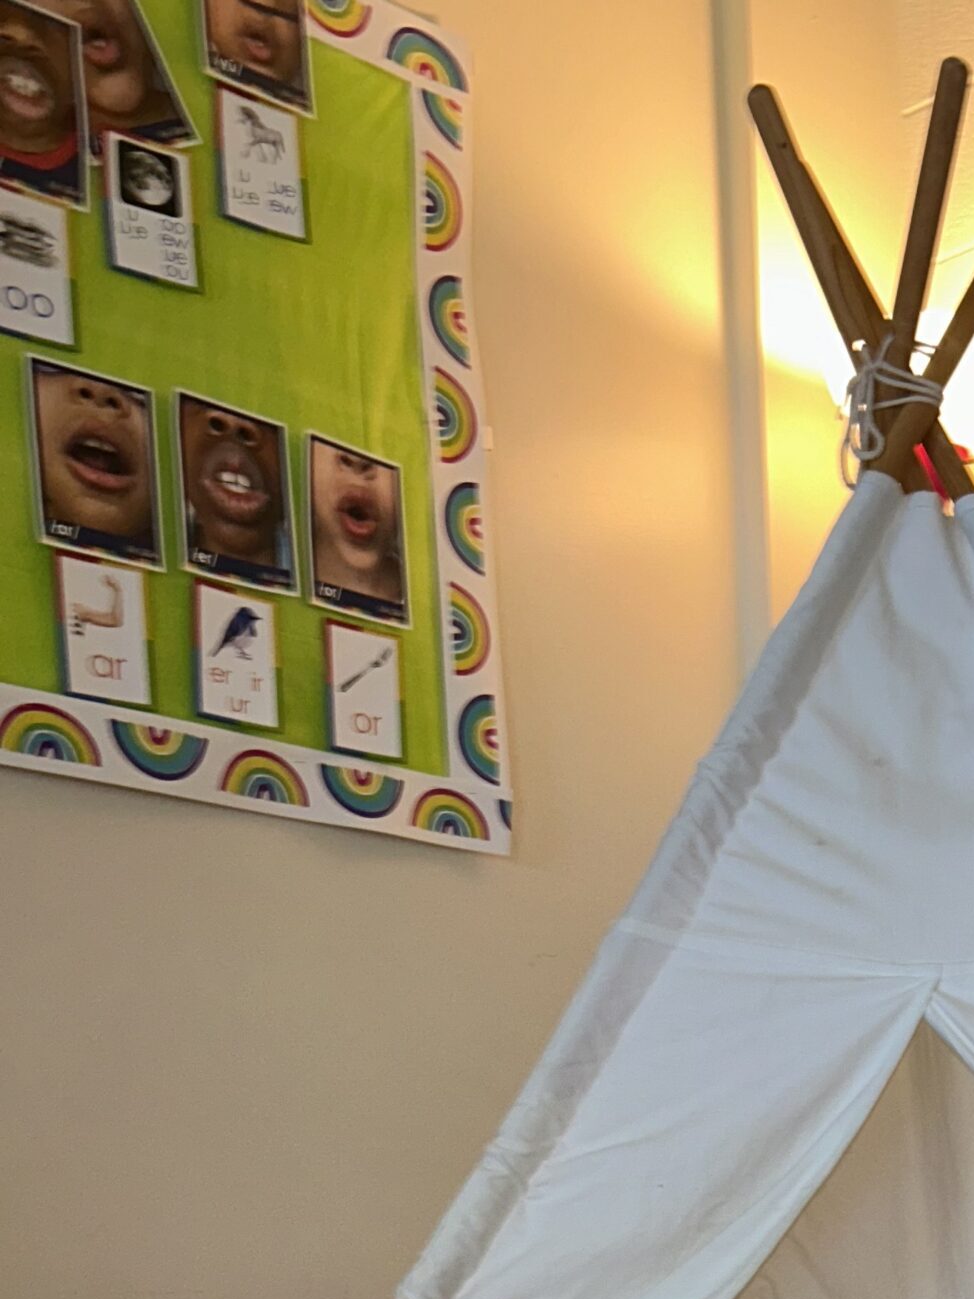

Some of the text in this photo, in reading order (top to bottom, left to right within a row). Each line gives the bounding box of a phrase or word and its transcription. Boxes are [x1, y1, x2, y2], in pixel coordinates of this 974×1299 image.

[88, 654, 127, 680] ar
[208, 667, 232, 684] er
[229, 697, 250, 714] ur
[353, 713, 382, 736] or
